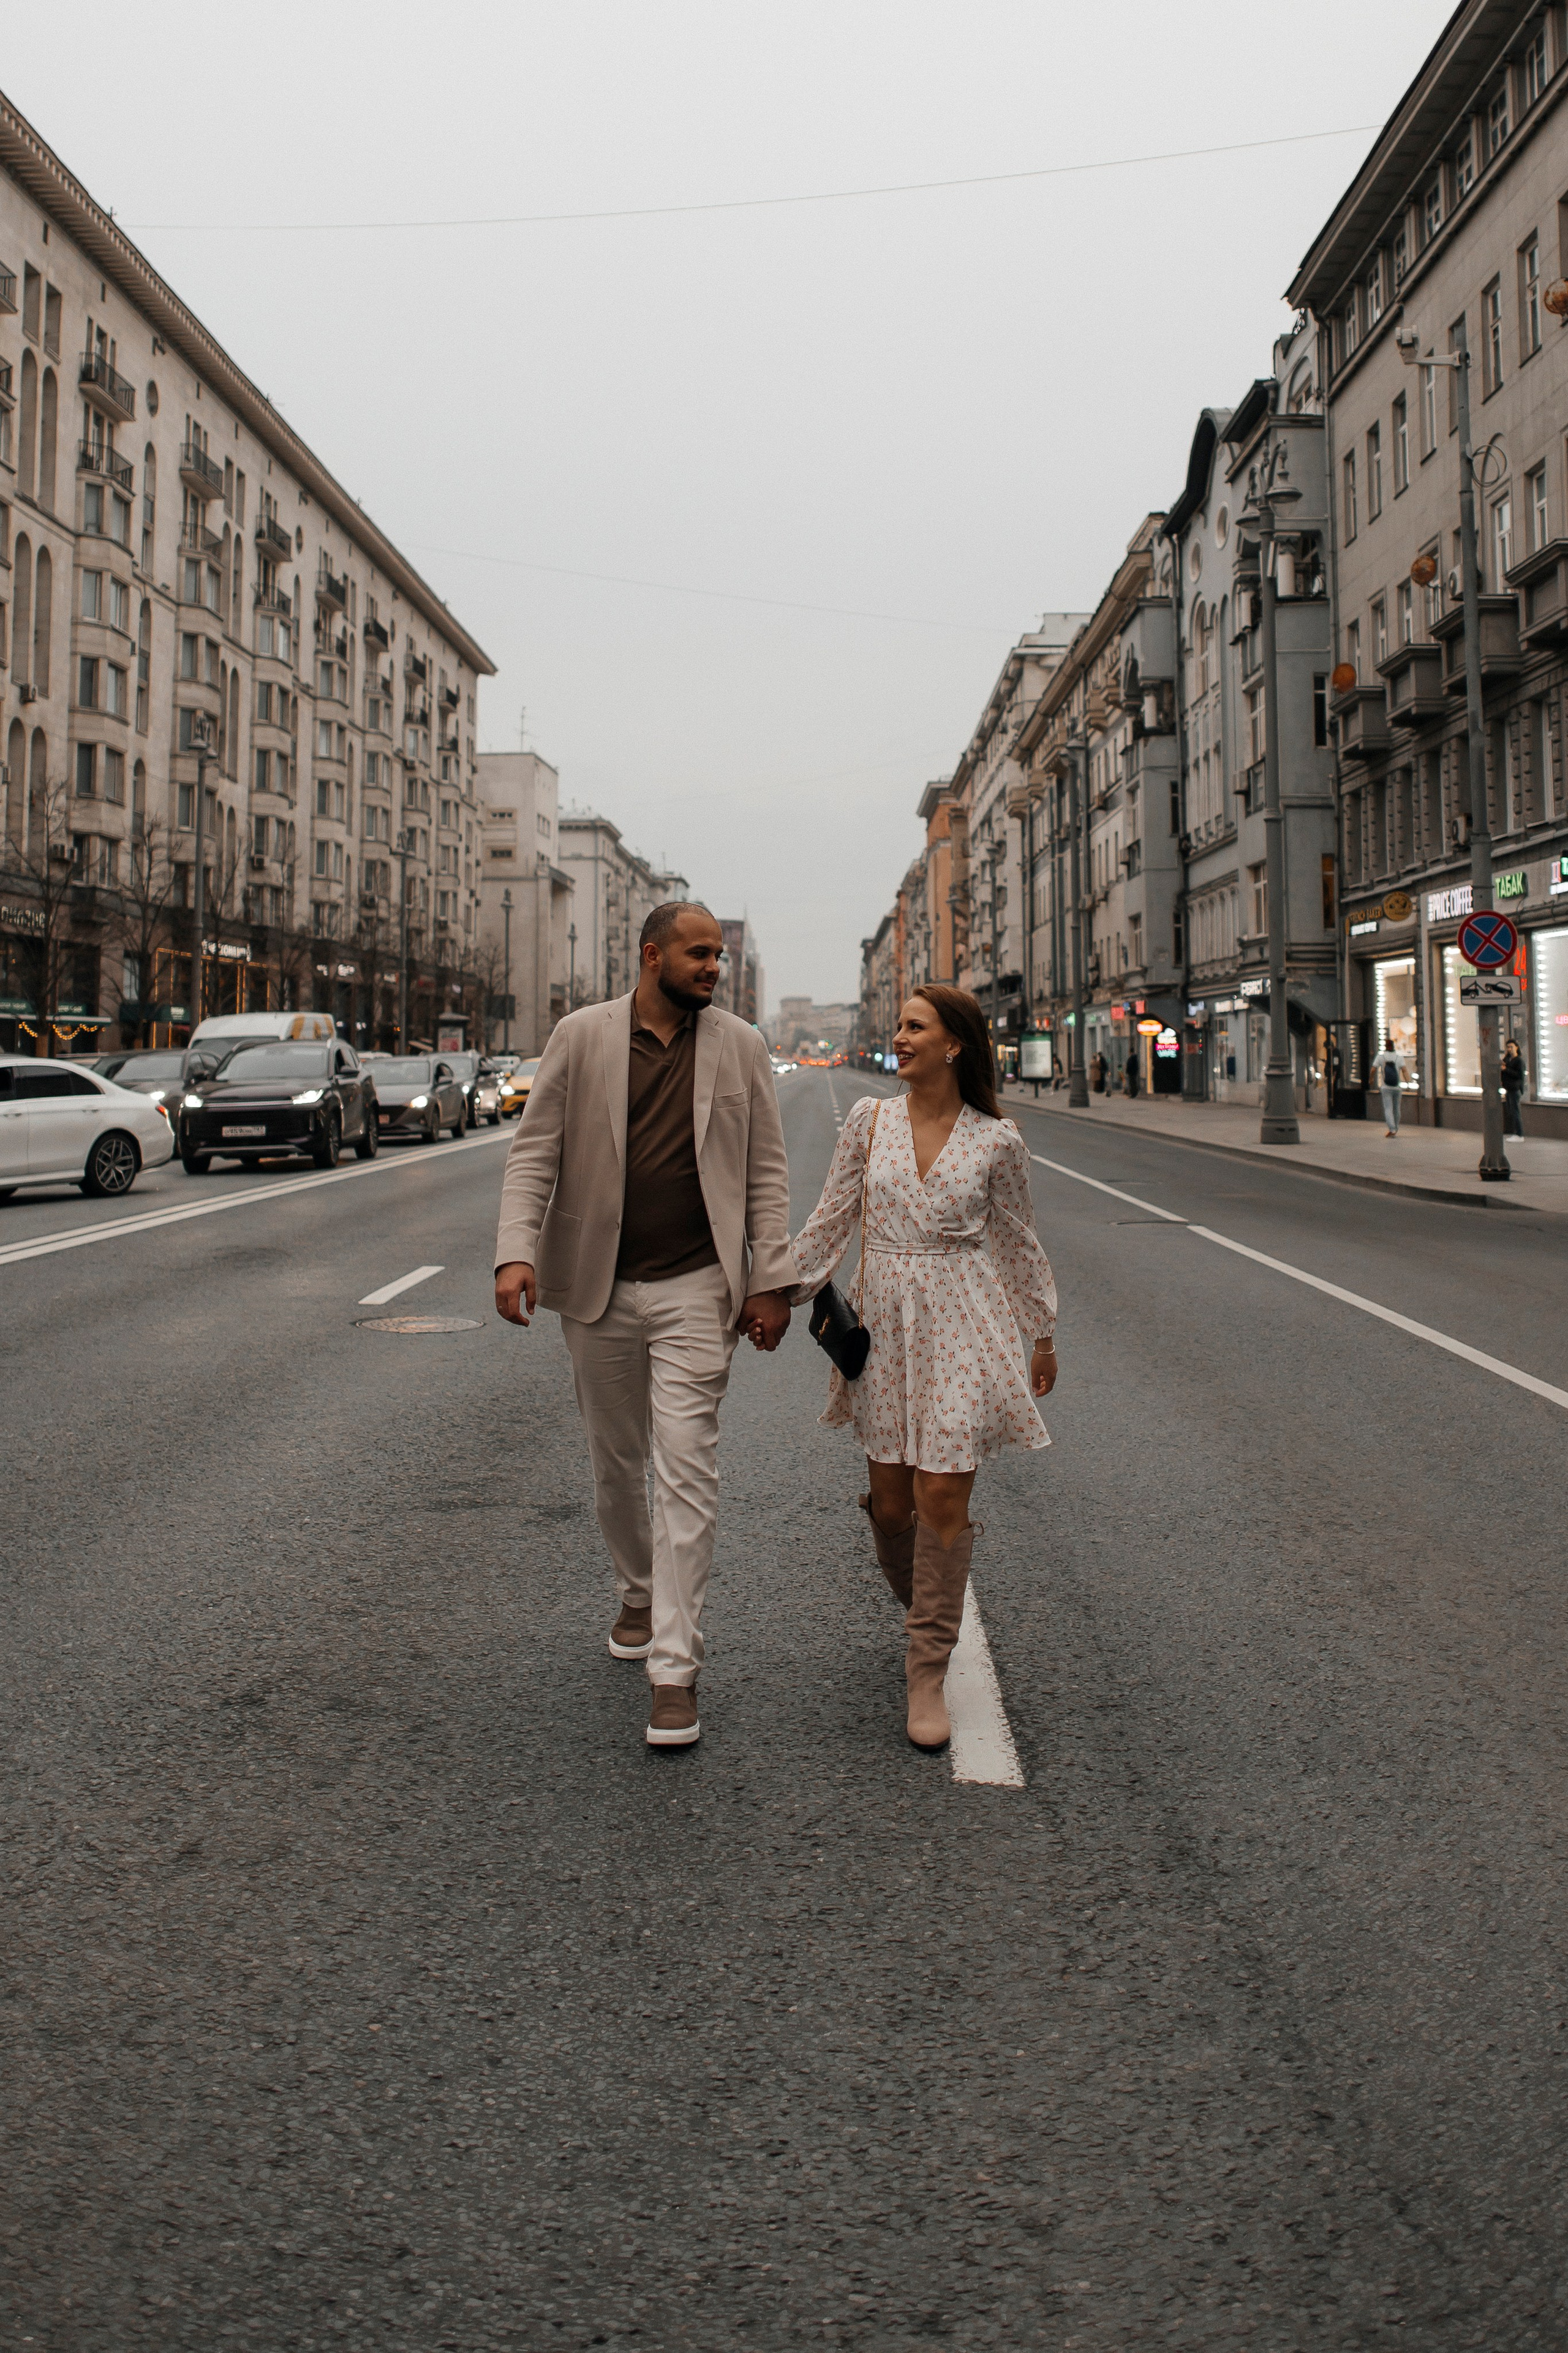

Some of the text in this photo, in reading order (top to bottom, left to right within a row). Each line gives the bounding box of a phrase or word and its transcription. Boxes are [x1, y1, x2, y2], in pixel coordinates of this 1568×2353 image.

[1495, 872, 1523, 899] ТАБАК
[1433, 885, 1473, 921] PRICE COFFEE
[1513, 945, 1526, 976] 24
